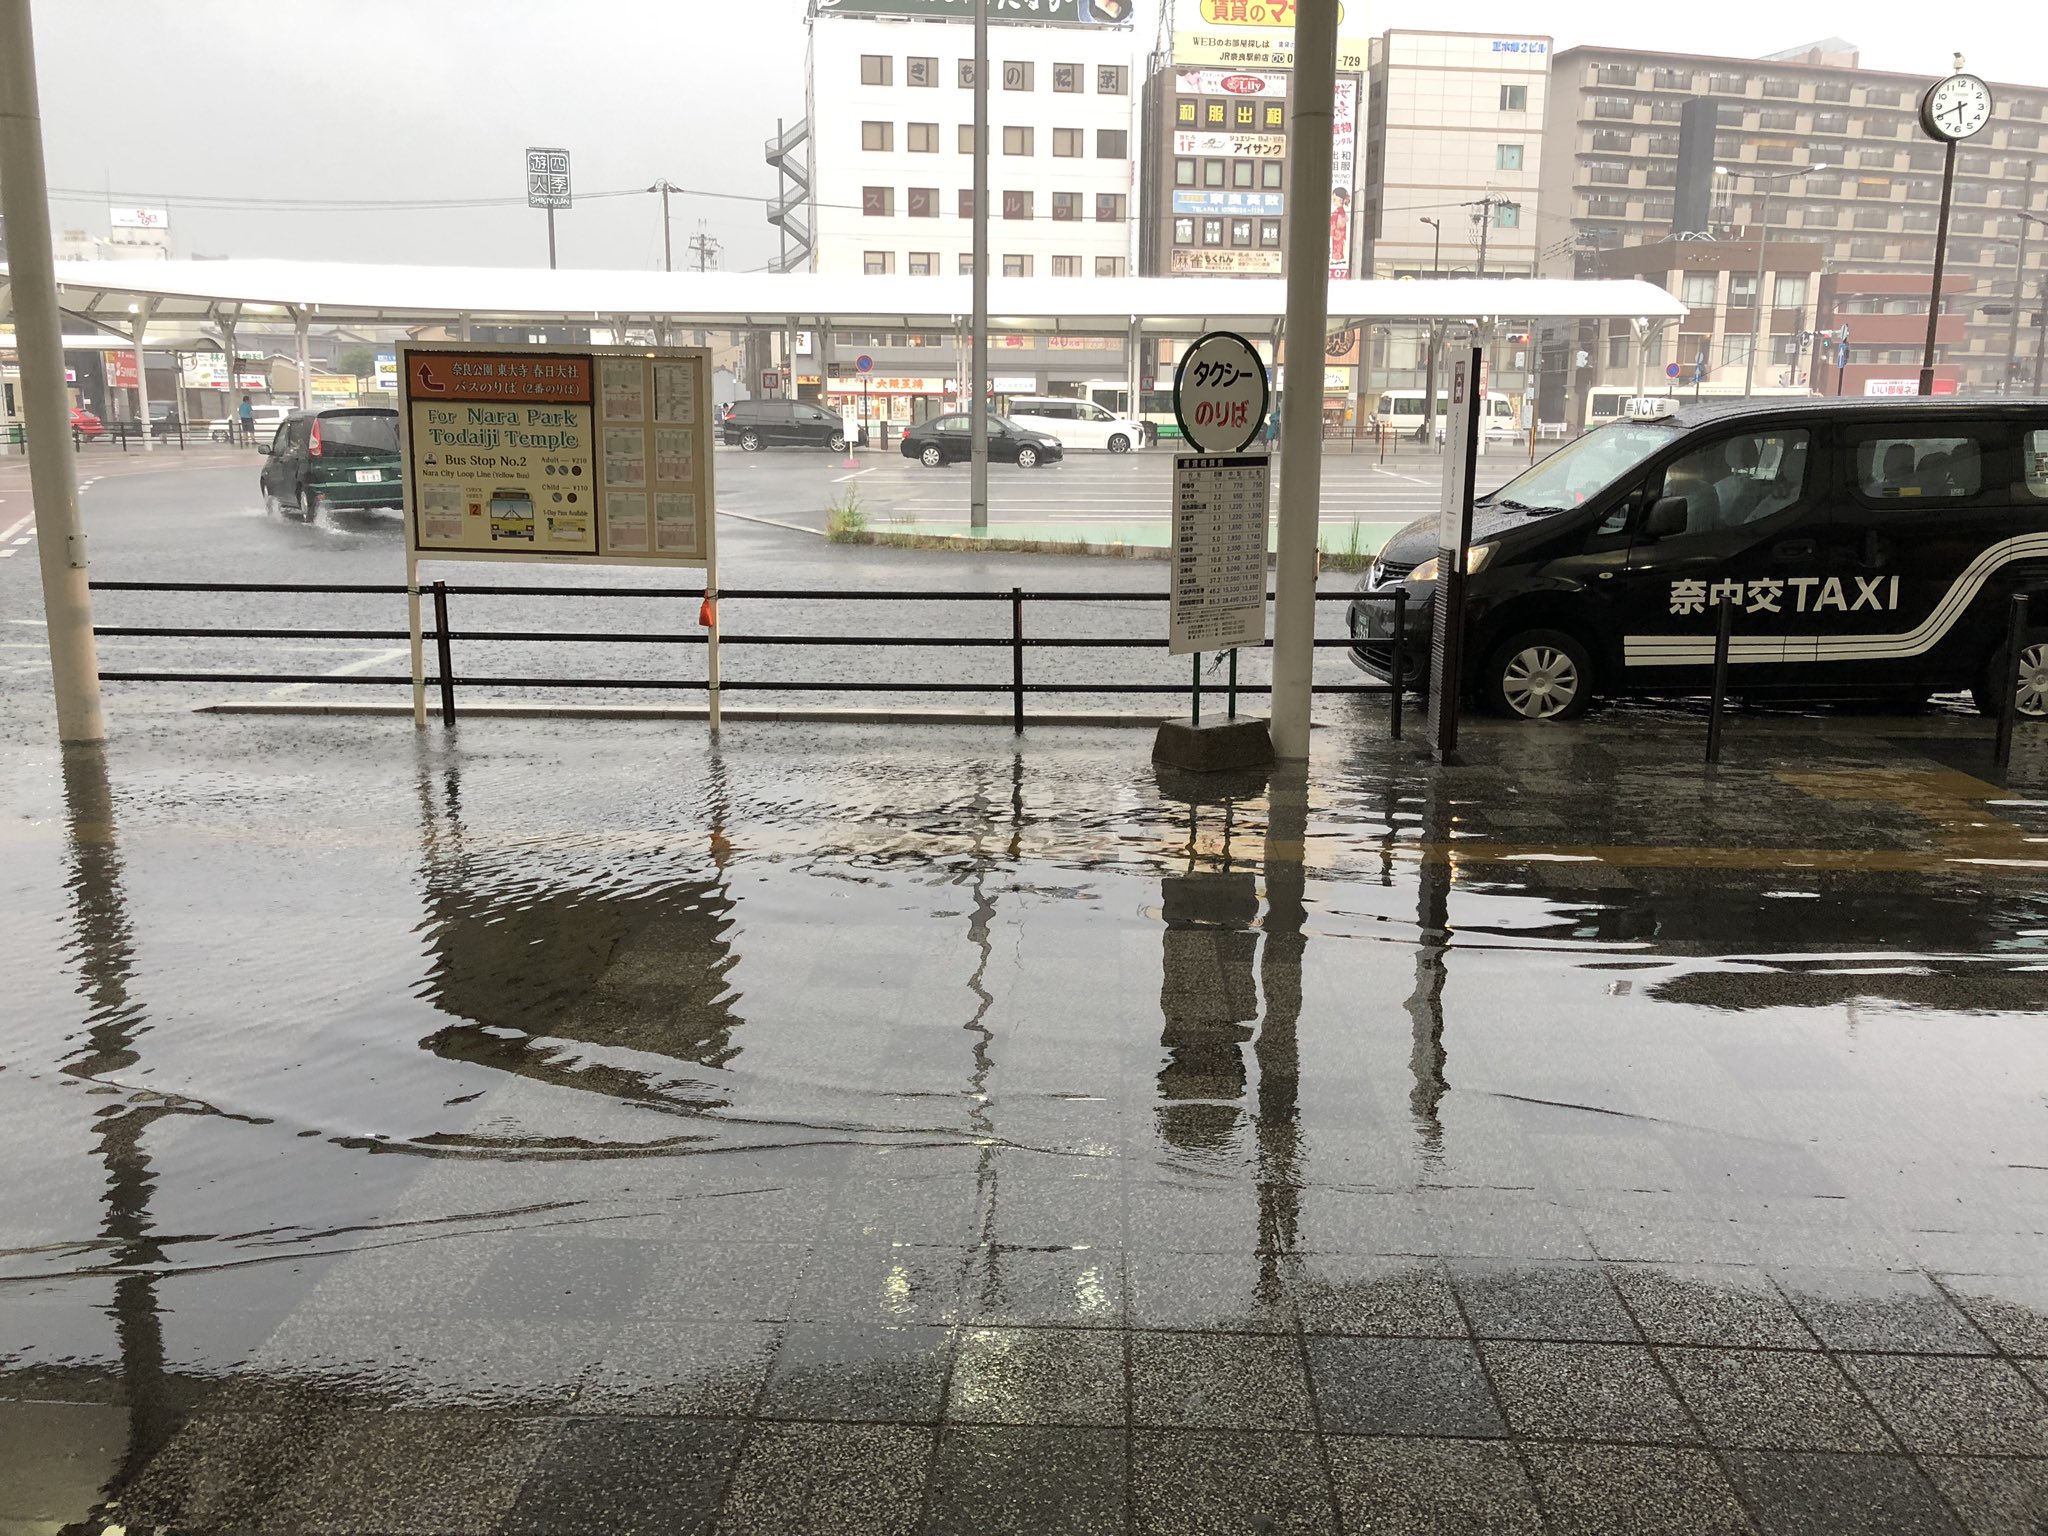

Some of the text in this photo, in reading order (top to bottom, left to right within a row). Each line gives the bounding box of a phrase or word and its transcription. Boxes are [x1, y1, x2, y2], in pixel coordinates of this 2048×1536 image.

[1219, 52, 1269, 62] JR奈良駅前店
[1240, 81, 1262, 93] Lily
[1179, 142, 1195, 151] 1F
[452, 364, 579, 379] 奈良公園 東大寺 春日大社
[1193, 361, 1253, 388] タクシー
[454, 380, 581, 395] バスのりば (2番のりば)
[1872, 385, 1918, 394] いい部屋ネッ
[1195, 400, 1250, 428] のりば
[1634, 399, 1655, 415] NCK
[428, 407, 577, 427] For Nara Park
[428, 428, 578, 451] Todaiji Temple
[445, 454, 526, 468] Bus Stop No.2
[422, 469, 439, 477] Nara
[441, 470, 455, 479] City
[457, 470, 475, 480] Loop
[472, 503, 478, 516] 2
